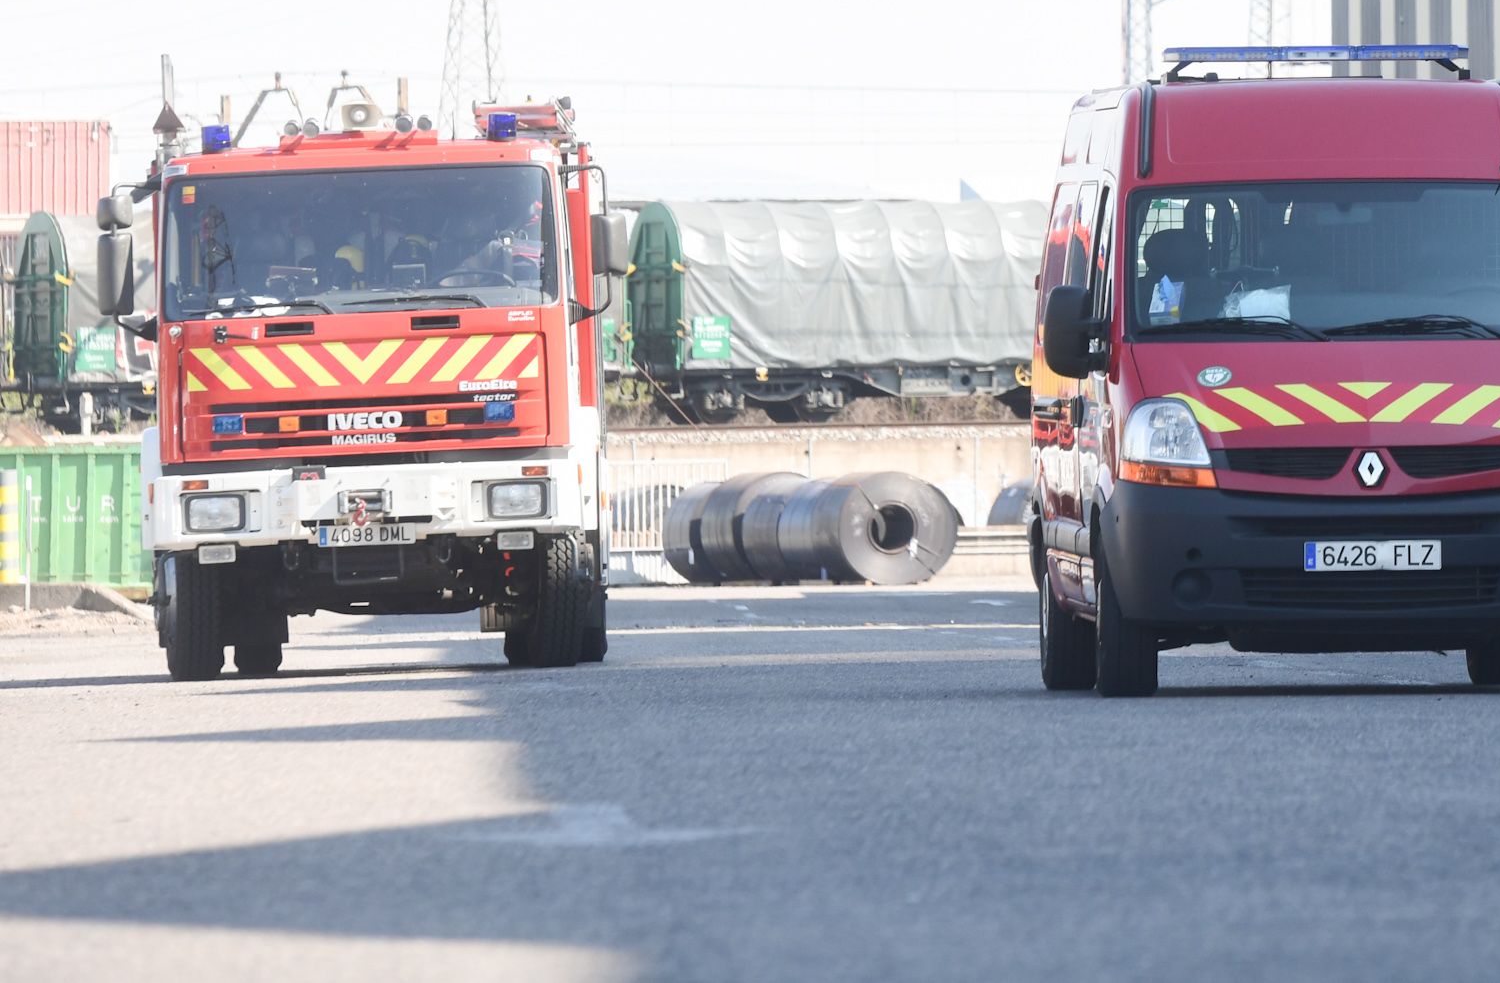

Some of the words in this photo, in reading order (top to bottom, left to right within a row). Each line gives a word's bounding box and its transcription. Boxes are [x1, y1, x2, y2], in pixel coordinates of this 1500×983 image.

[327, 410, 403, 431] IVECO
[331, 432, 397, 446] MAGIRUS
[331, 526, 374, 543] 4098
[379, 525, 412, 541] DML
[1322, 545, 1377, 567] 6426
[1393, 544, 1434, 566] FLZ
